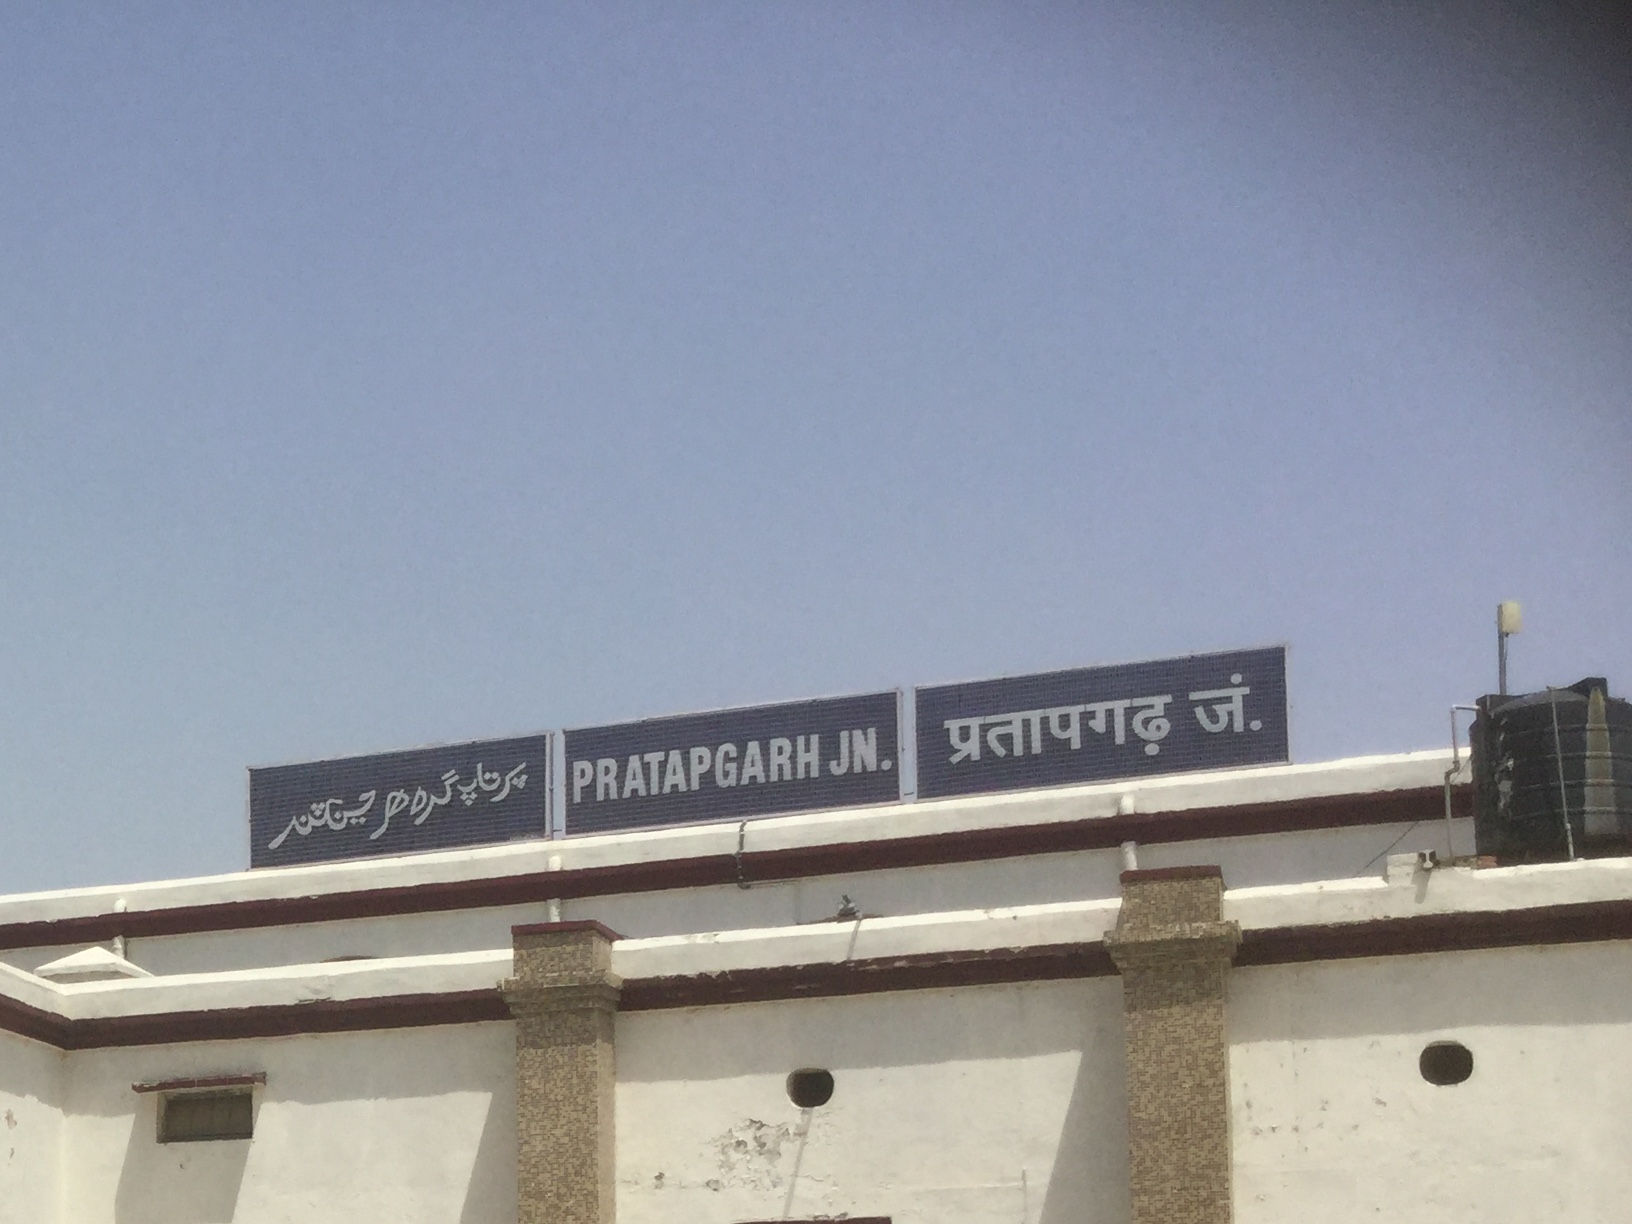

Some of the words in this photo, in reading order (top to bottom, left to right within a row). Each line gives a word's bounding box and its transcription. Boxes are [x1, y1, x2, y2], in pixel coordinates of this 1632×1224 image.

[942, 694, 1173, 765] प्रतापगढ़
[1188, 672, 1263, 733] जं.
[572, 733, 820, 804] PRATAPGARH
[829, 727, 893, 776] JN.
